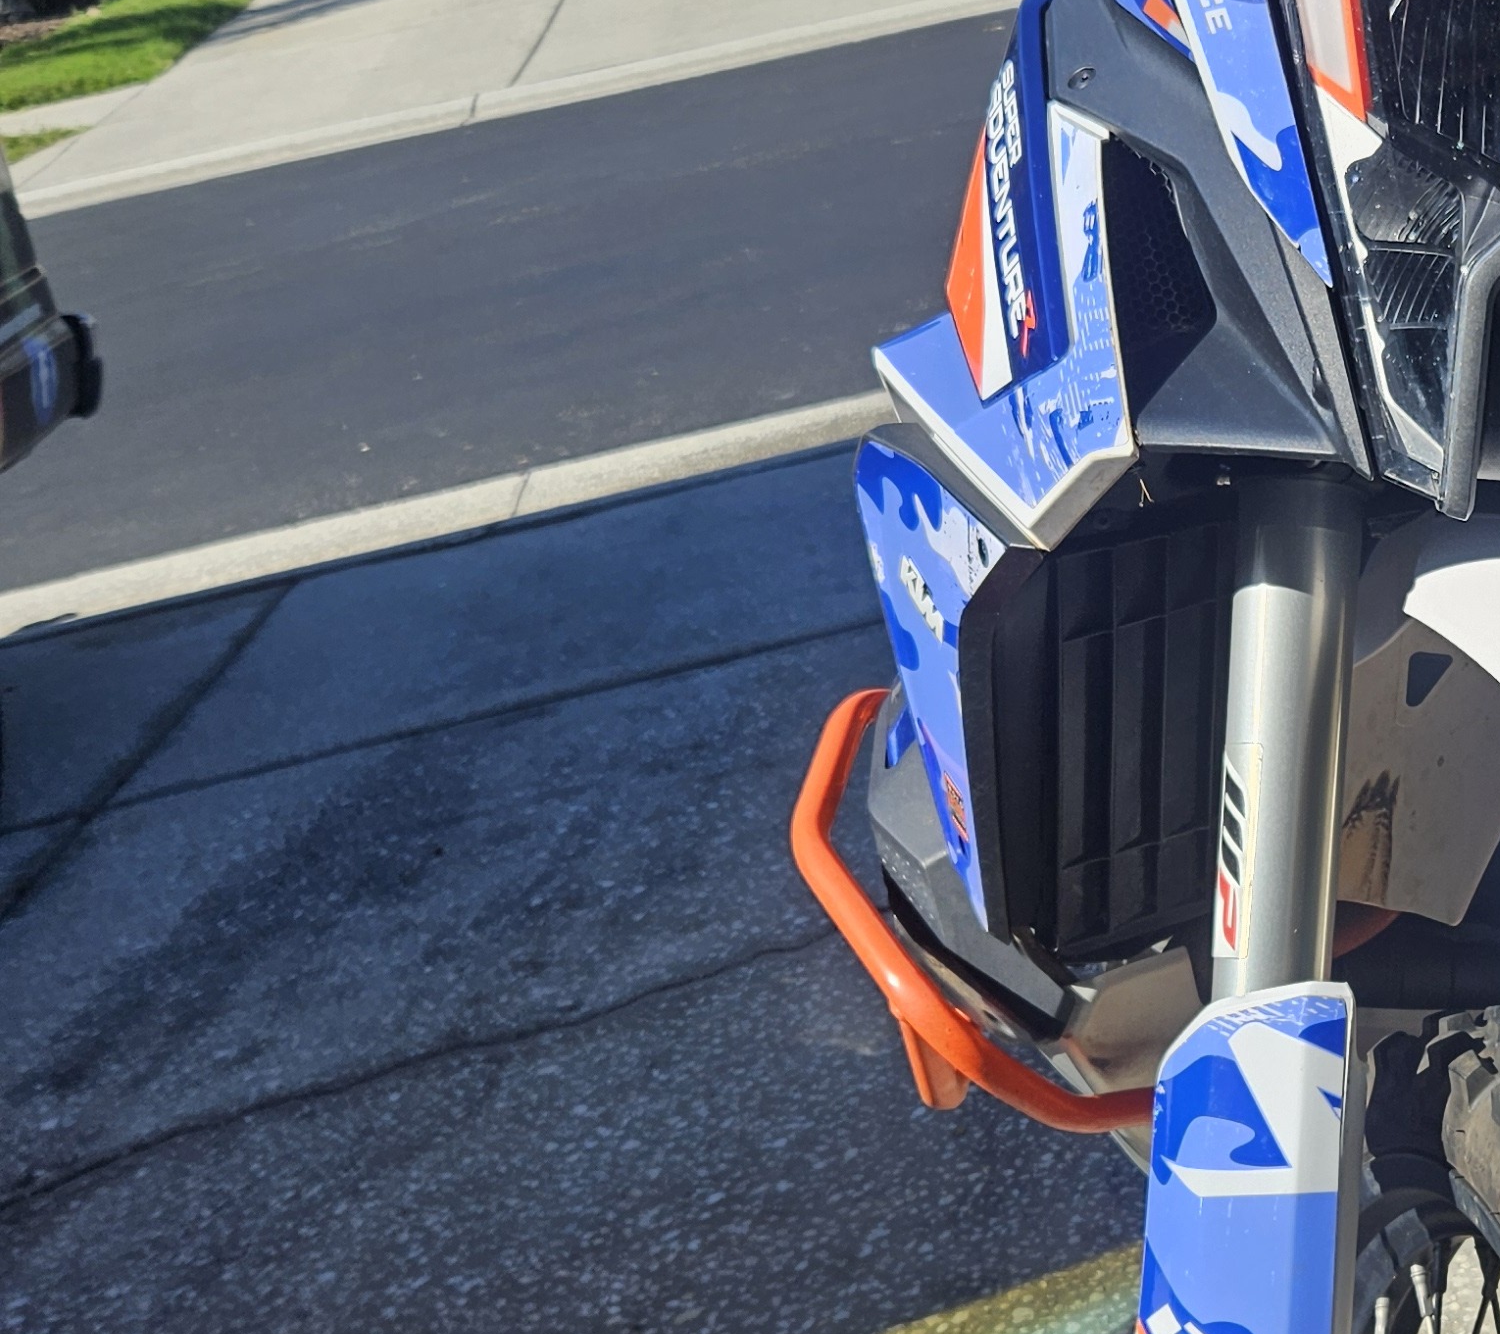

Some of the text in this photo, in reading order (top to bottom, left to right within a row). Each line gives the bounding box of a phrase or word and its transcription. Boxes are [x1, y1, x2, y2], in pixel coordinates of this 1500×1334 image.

[1002, 59, 1023, 168] SUPER
[986, 78, 1026, 340] ADVENTURE
[900, 554, 944, 644] KTM
